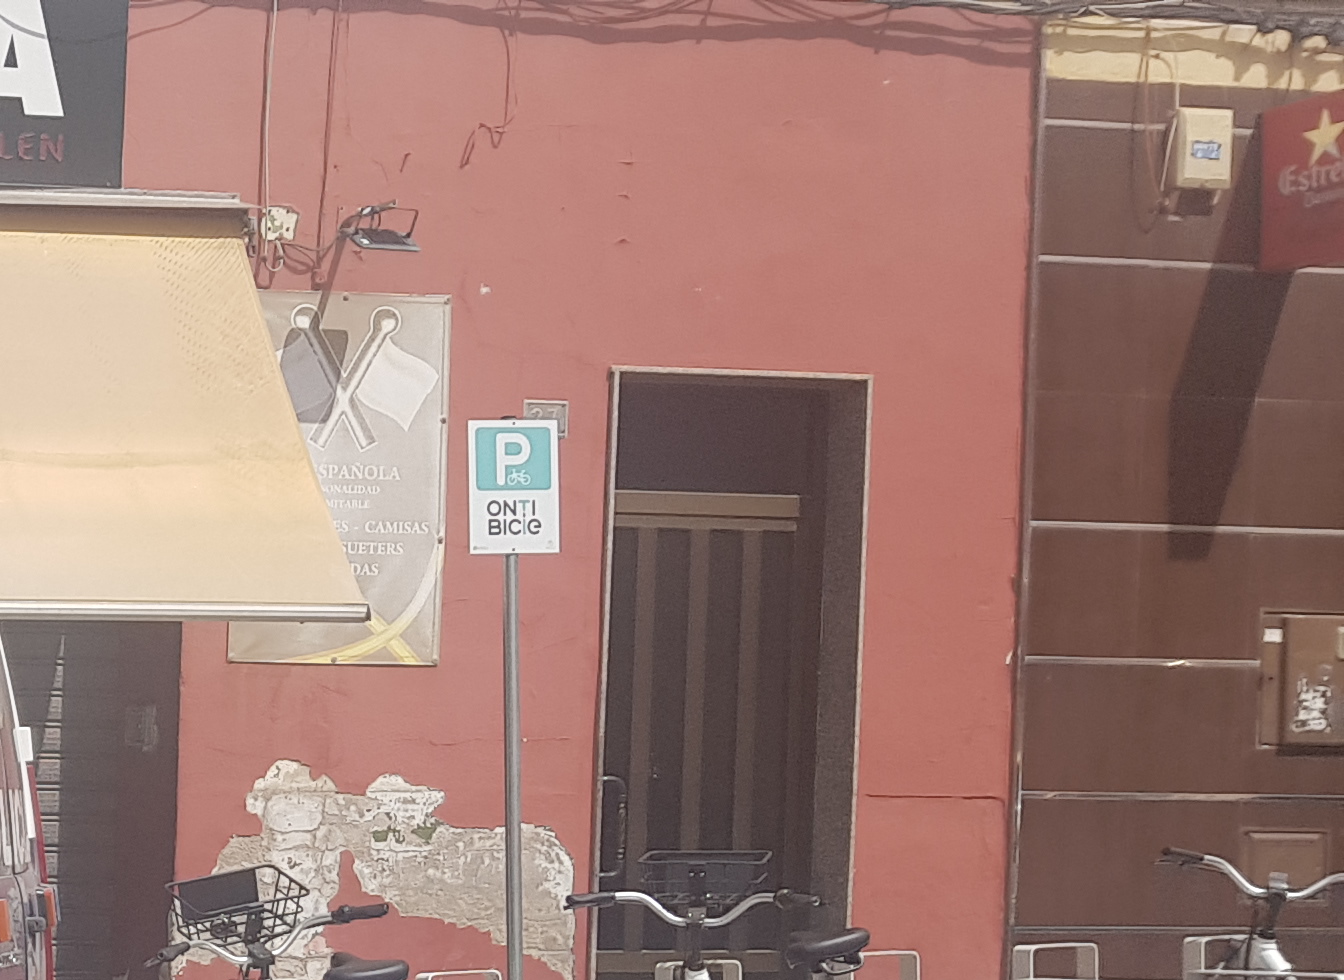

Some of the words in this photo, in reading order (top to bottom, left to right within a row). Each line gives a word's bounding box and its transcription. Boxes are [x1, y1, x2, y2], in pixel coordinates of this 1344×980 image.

[495, 432, 532, 486] P
[486, 499, 536, 517] ONTI
[364, 520, 430, 534] CAMISAS
